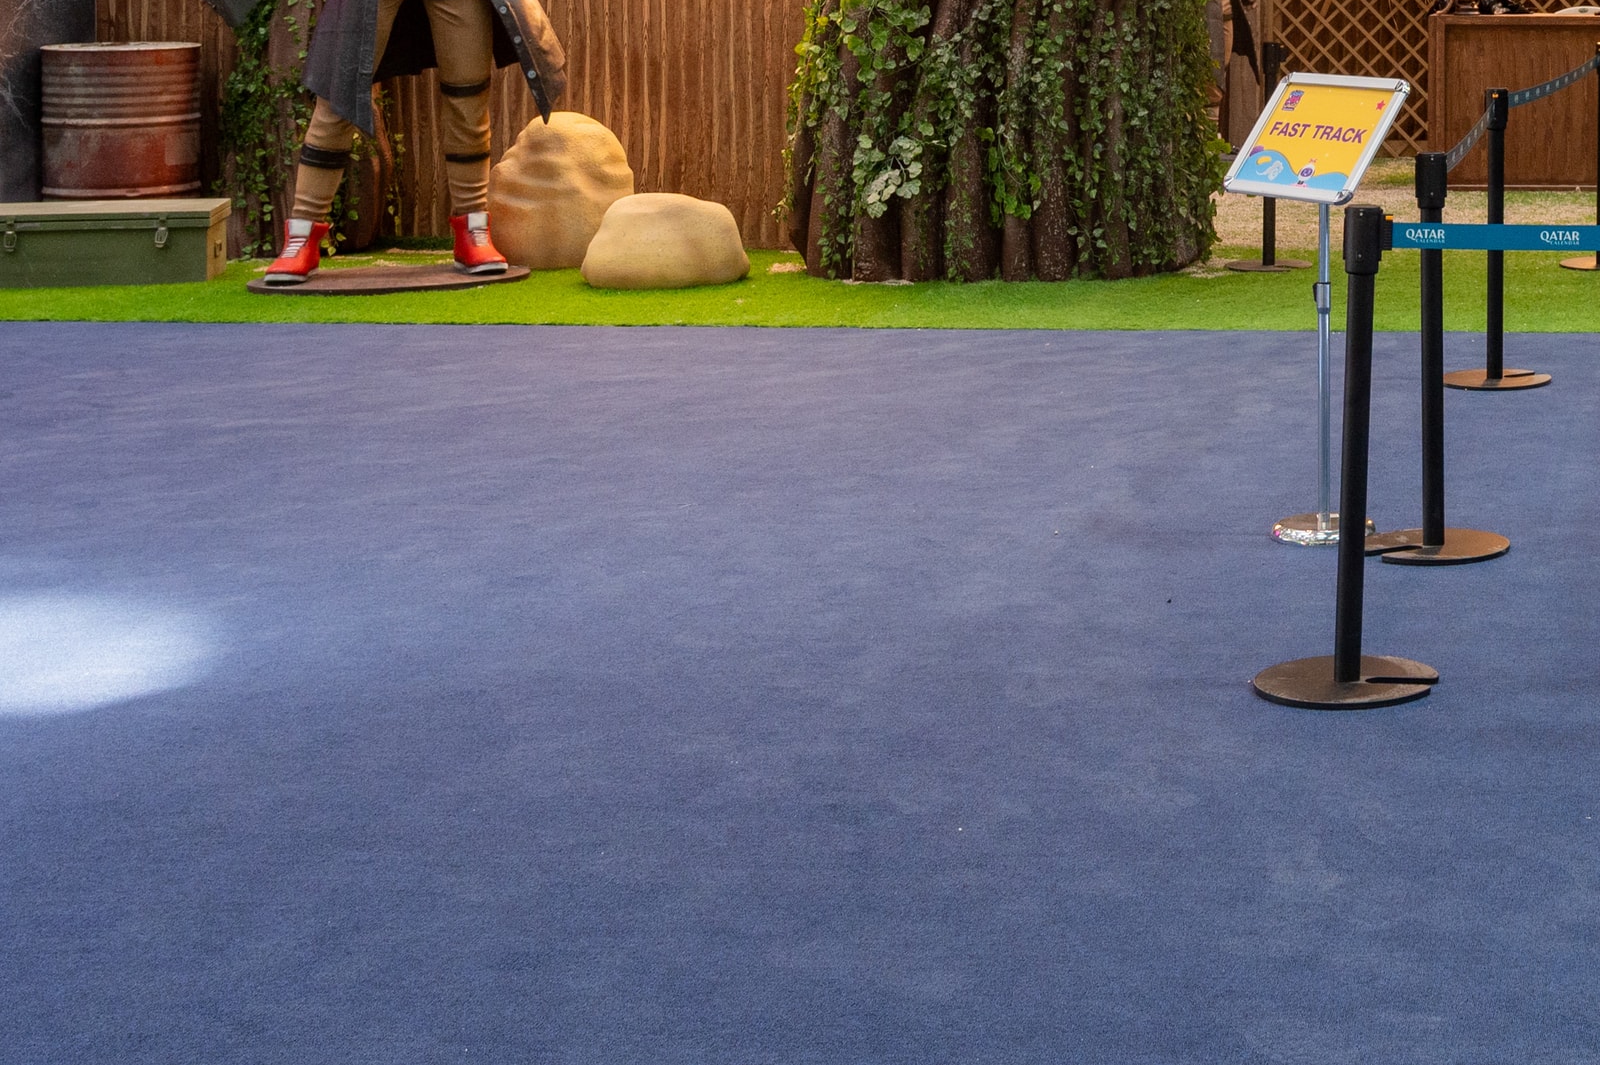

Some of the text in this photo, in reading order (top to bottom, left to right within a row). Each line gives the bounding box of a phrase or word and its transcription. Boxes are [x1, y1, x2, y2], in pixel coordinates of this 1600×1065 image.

[1269, 121, 1367, 144] FAST TRACK
[1405, 228, 1445, 240] QATAR
[1540, 230, 1580, 243] QATAR
